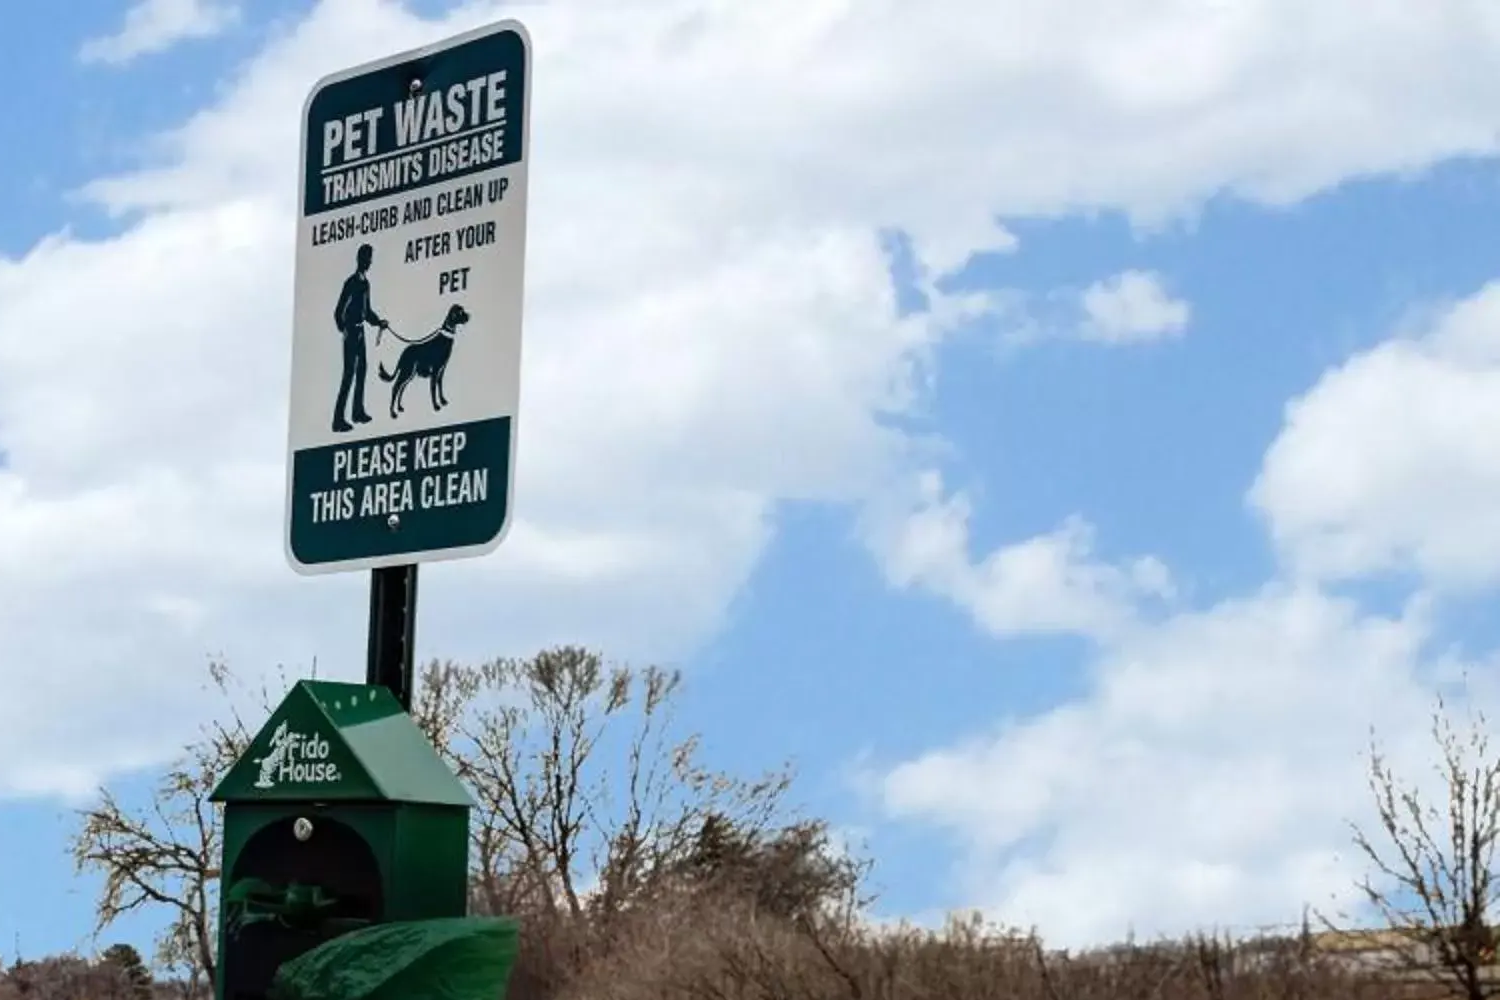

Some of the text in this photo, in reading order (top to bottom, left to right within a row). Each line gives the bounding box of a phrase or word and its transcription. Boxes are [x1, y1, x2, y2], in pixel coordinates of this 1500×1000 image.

[323, 70, 507, 166] PET WASTE
[322, 130, 505, 204] TRANSMITS DISEASE
[312, 177, 509, 246] LEASH-CURB AND CLEAN UP
[404, 221, 496, 263] AFTER YOUR
[439, 267, 470, 294] PET
[333, 431, 466, 482] PLEASE KEEP
[310, 468, 488, 523] THIS AREA CLEAN
[279, 756, 338, 782] House
[287, 732, 330, 759] Fido
